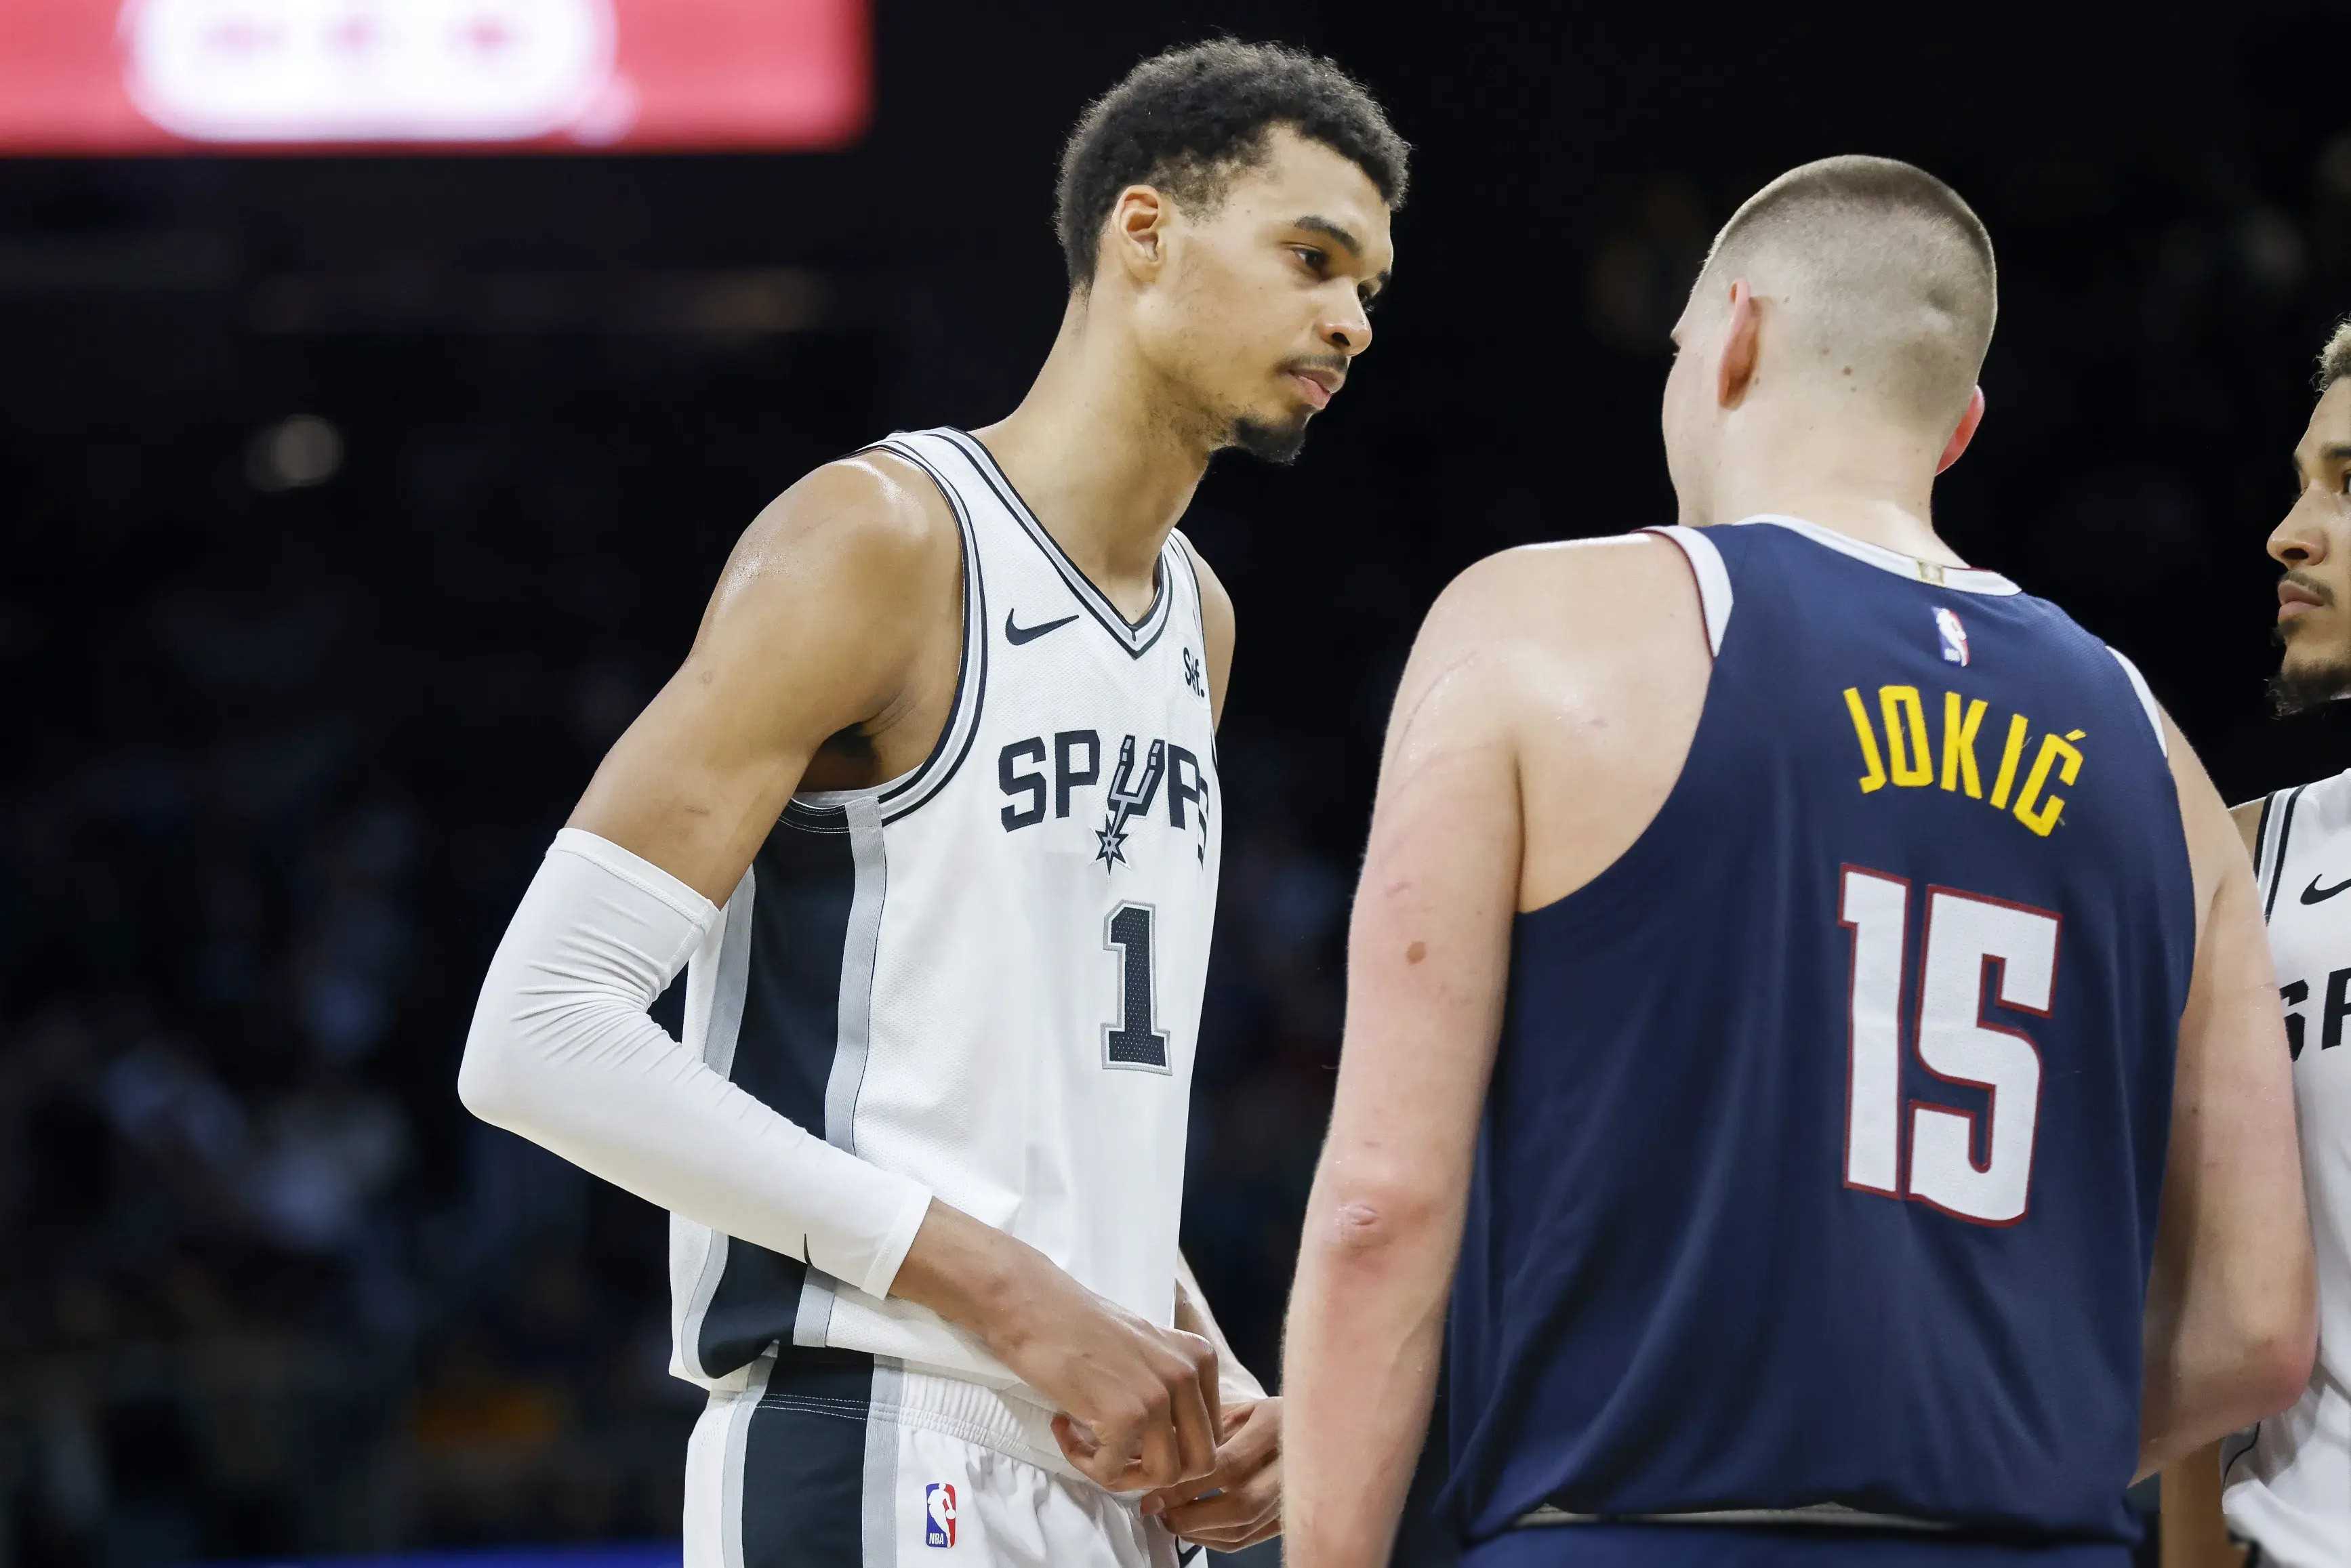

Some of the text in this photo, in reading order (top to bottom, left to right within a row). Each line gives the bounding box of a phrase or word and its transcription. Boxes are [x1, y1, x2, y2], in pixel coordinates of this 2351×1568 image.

[1844, 684, 2087, 837] JOKIĆ
[1100, 900, 1172, 1075] 1
[1838, 863, 2063, 1227] 15
[928, 1533, 944, 1545] NBA
